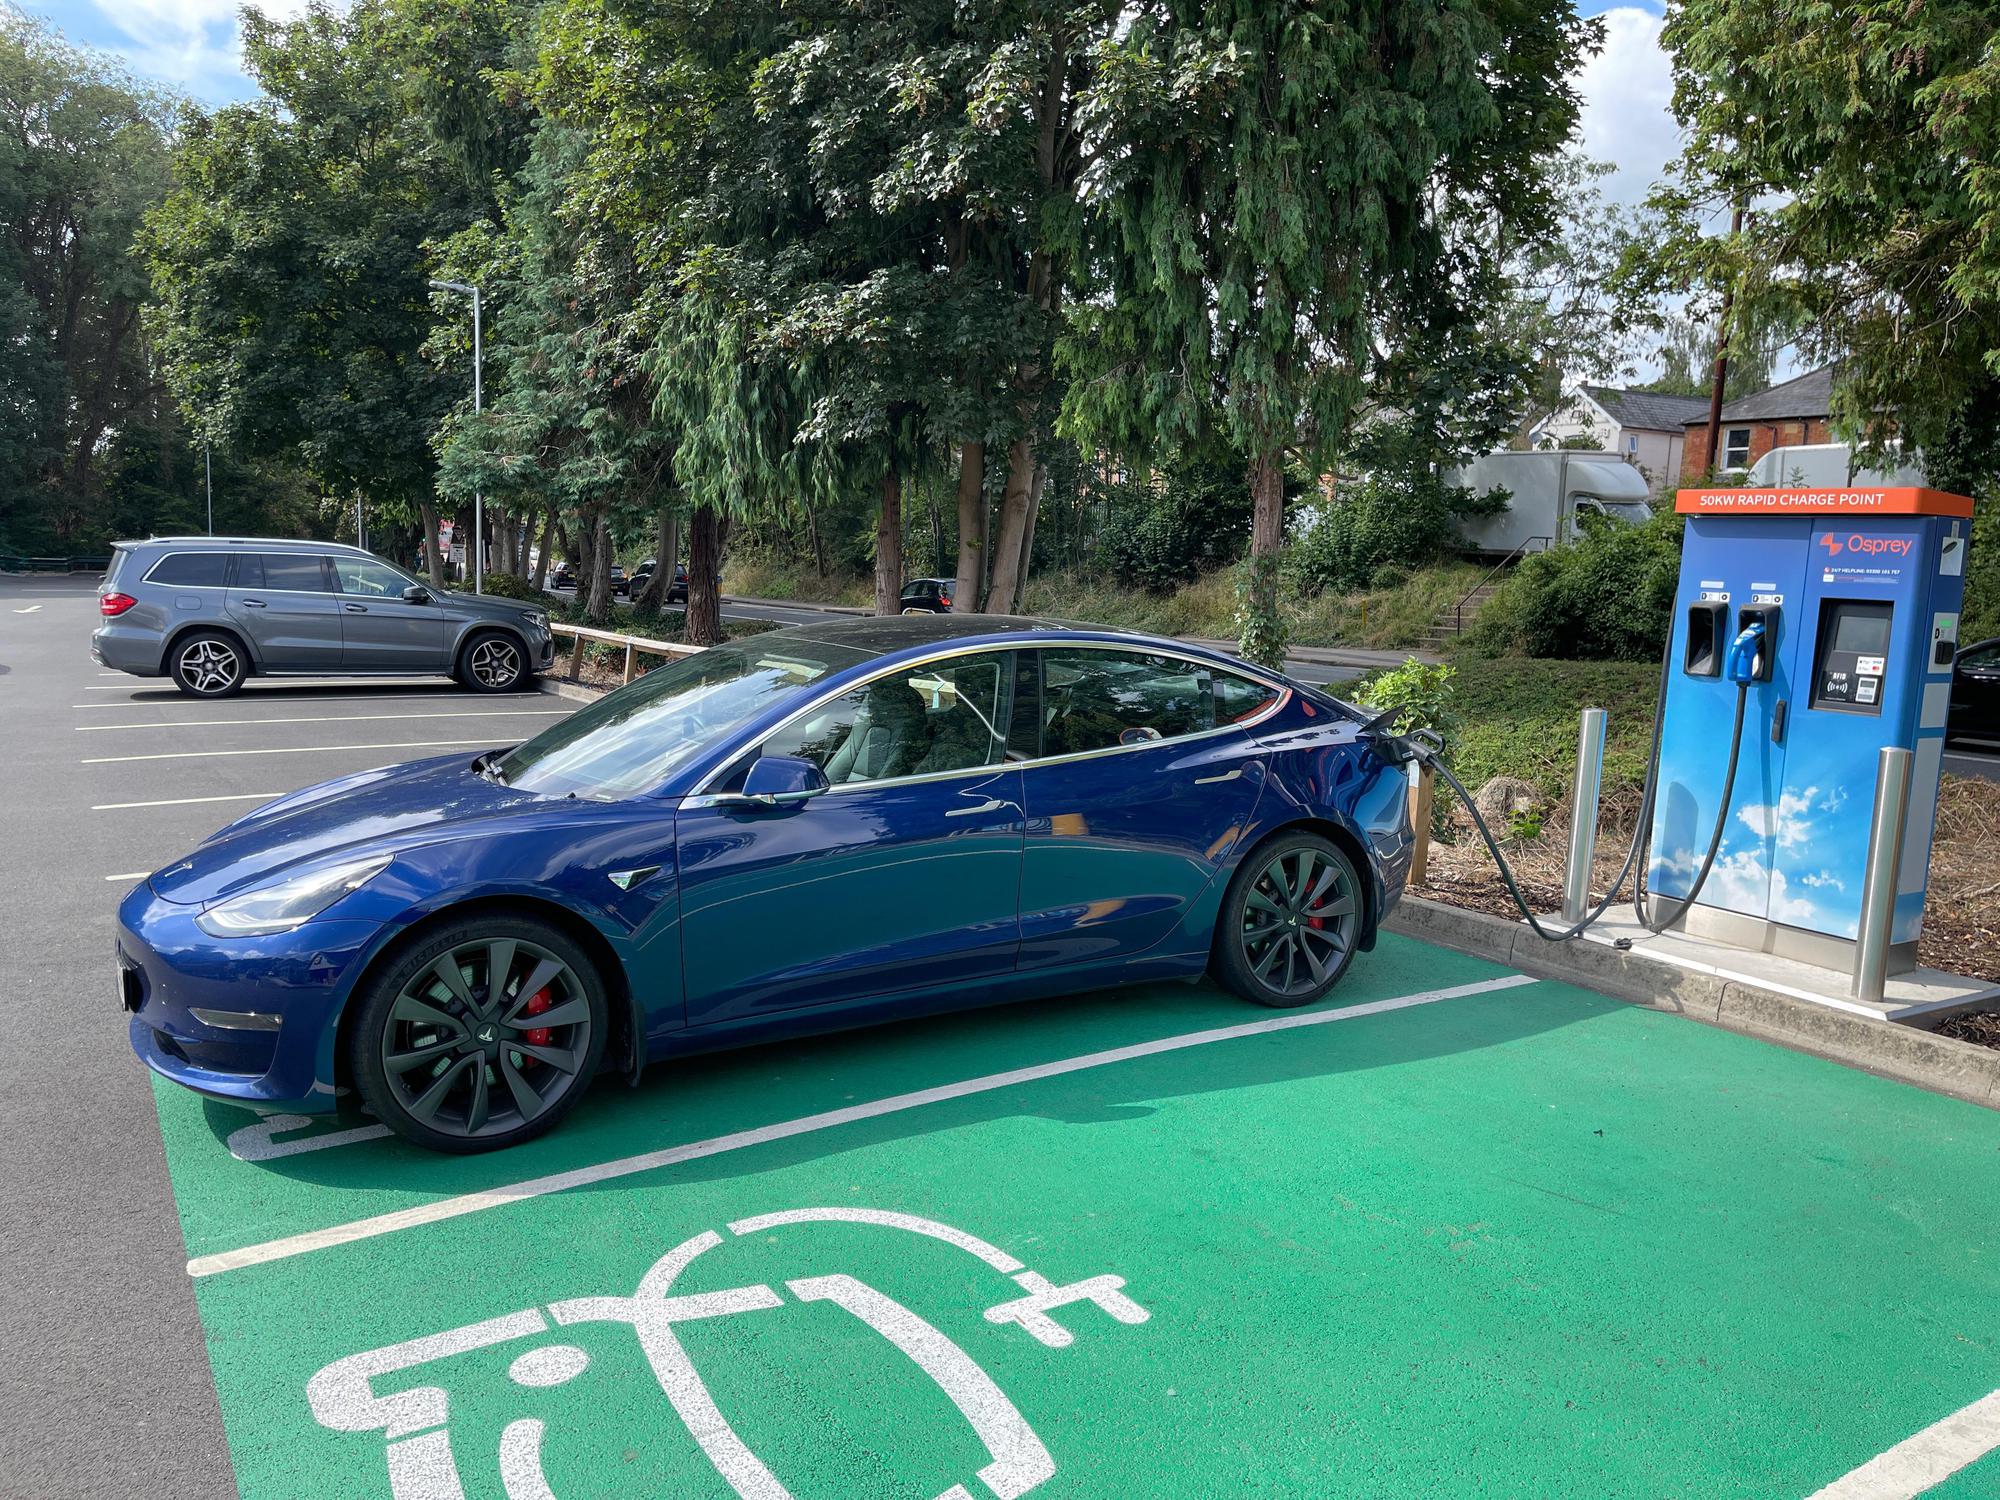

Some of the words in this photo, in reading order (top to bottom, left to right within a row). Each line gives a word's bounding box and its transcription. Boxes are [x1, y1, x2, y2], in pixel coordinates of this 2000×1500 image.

[1700, 495, 1735, 506] 50KW
[1737, 495, 1777, 506] RAPID
[1779, 494, 1836, 505] CHARGE
[1839, 493, 1885, 505] POINT
[1848, 535, 1912, 556] Osprey
